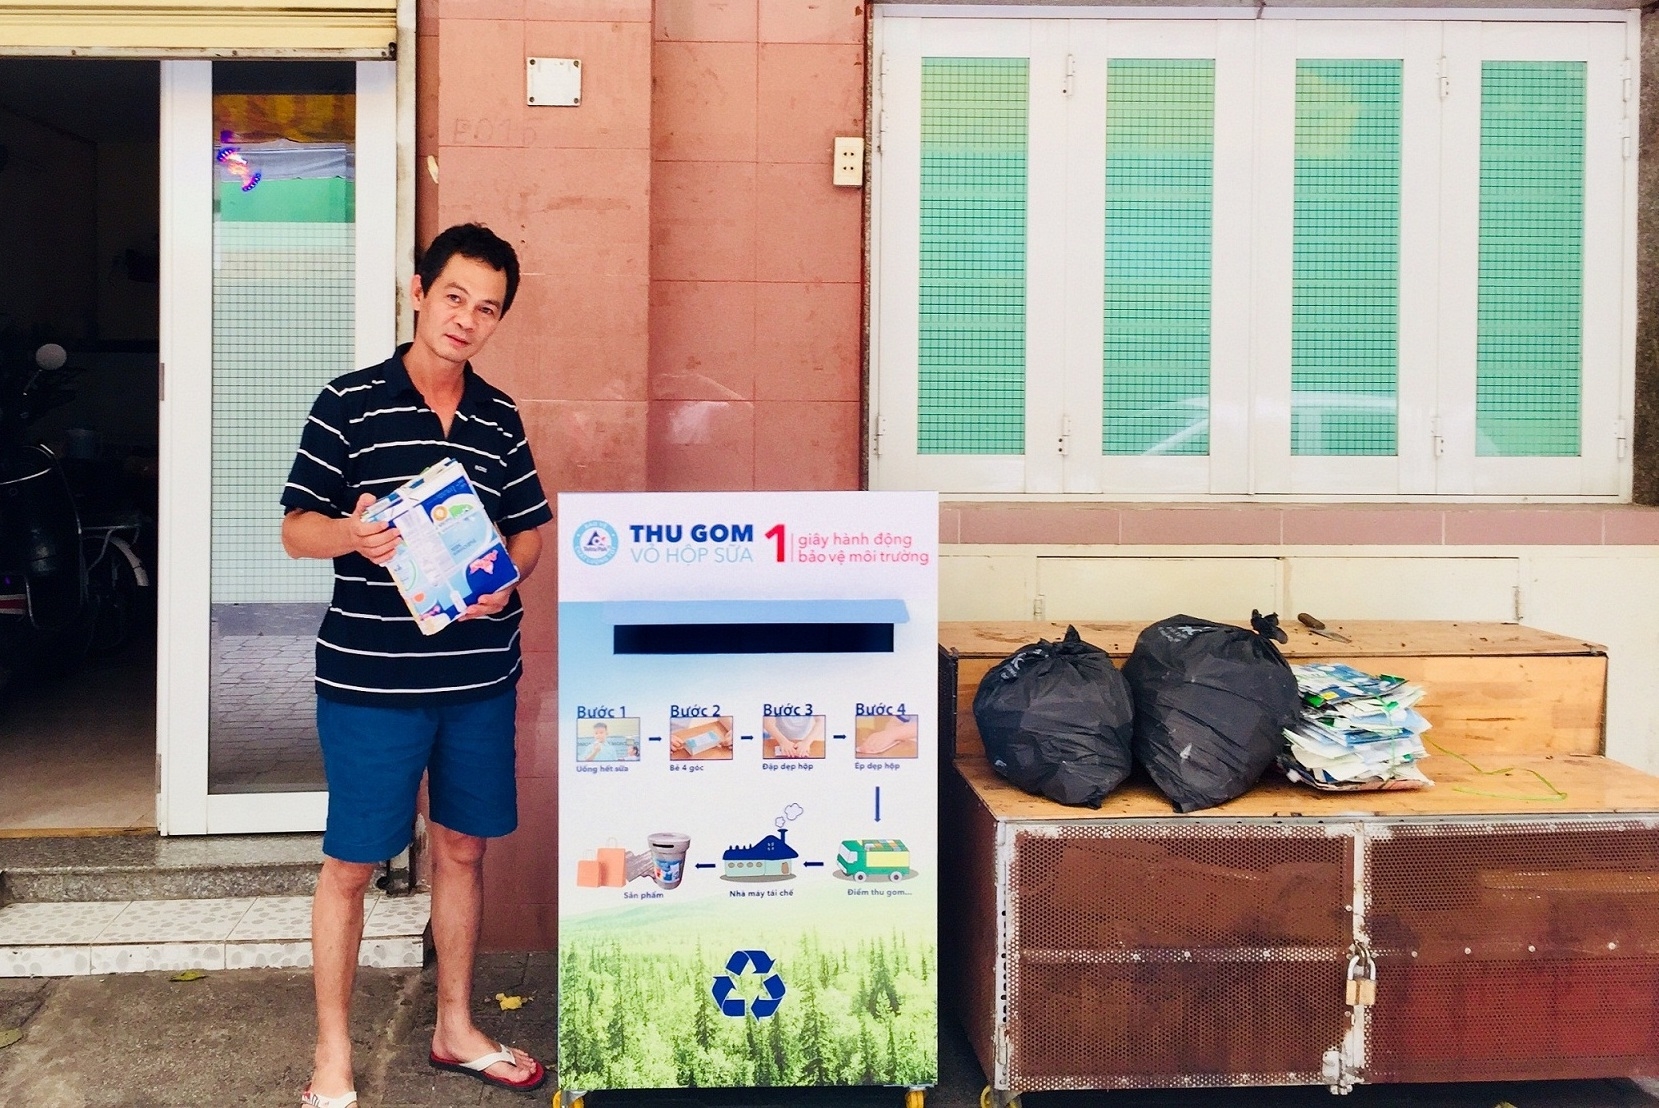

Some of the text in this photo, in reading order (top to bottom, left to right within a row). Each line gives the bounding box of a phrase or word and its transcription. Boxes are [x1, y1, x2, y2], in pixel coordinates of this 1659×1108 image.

[629, 524, 683, 543] THU
[690, 523, 754, 543] GOM
[798, 532, 912, 549] giây hành động
[764, 523, 786, 564] 1
[630, 543, 659, 564] VỎ
[666, 544, 709, 566] HỘP
[714, 543, 754, 564] SỮA
[798, 549, 930, 565] bảo vệ môi trường
[577, 704, 627, 718] Bước 1
[669, 703, 721, 718] Bước 2
[763, 703, 814, 717] Bước 3
[856, 702, 906, 716] Bước 4
[870, 888, 885, 896] thu
